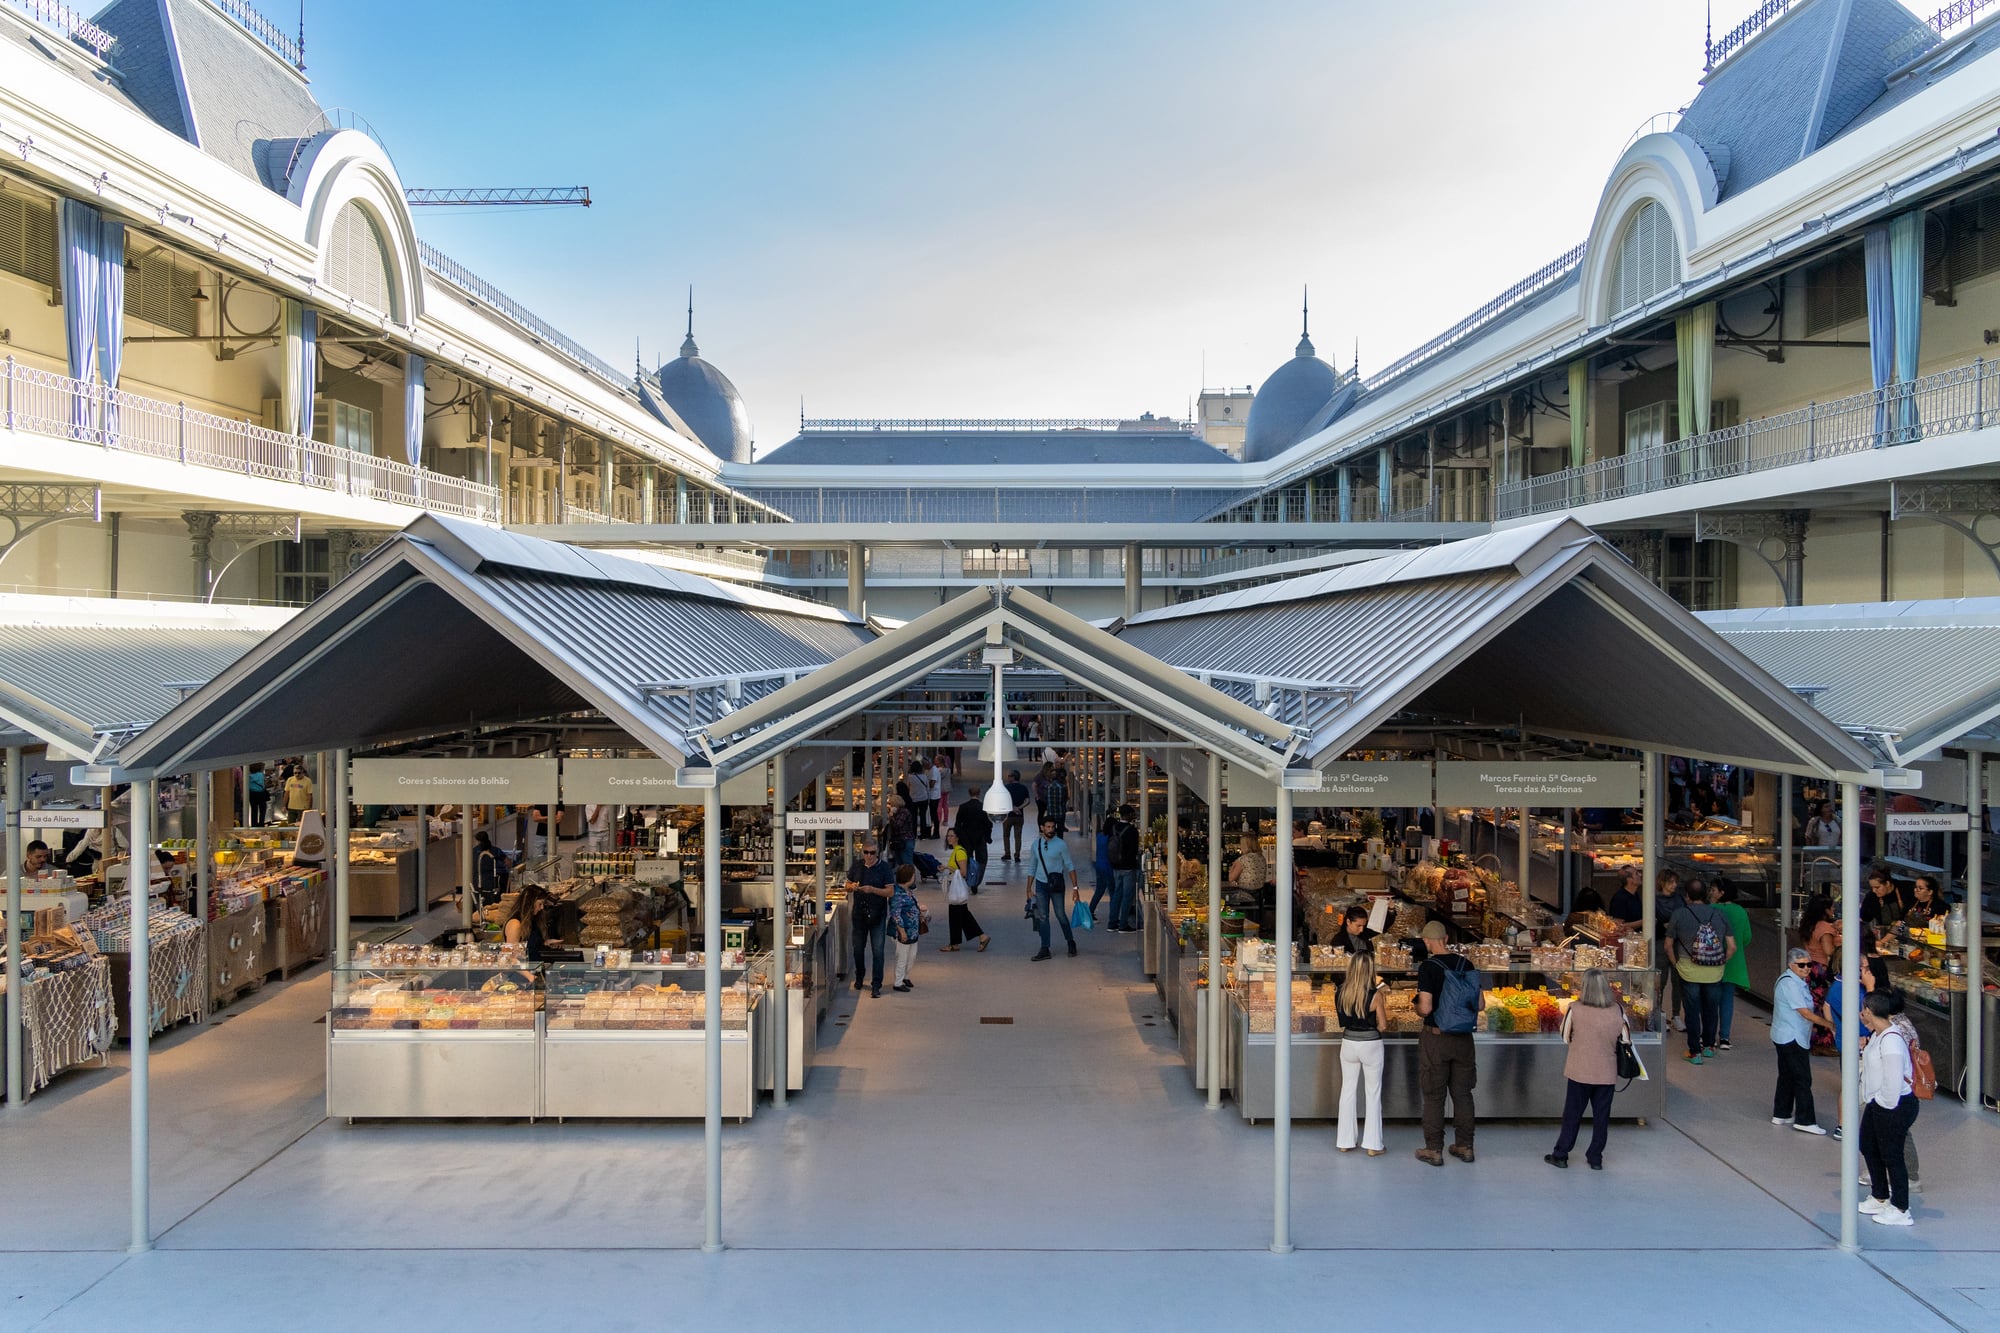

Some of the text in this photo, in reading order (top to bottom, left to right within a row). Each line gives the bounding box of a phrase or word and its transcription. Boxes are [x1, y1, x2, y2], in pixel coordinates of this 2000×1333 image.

[398, 776, 424, 785] Cores
[432, 776, 466, 785] Sabores
[467, 776, 479, 785] do
[480, 776, 510, 785] Bolhão
[608, 776, 634, 785] Cores
[1351, 774, 1389, 783] Geração
[1479, 774, 1512, 783] Marcos
[1513, 774, 1547, 783] Ferreira
[1560, 774, 1597, 784] Geração
[1331, 785, 1375, 793] Azeitonas
[1494, 784, 1583, 793] Teresa das Azeitonas
[27, 815, 80, 824] Rua da Aliança
[818, 816, 842, 824] Vitória
[1893, 818, 1952, 826] Rua das Virtudes
